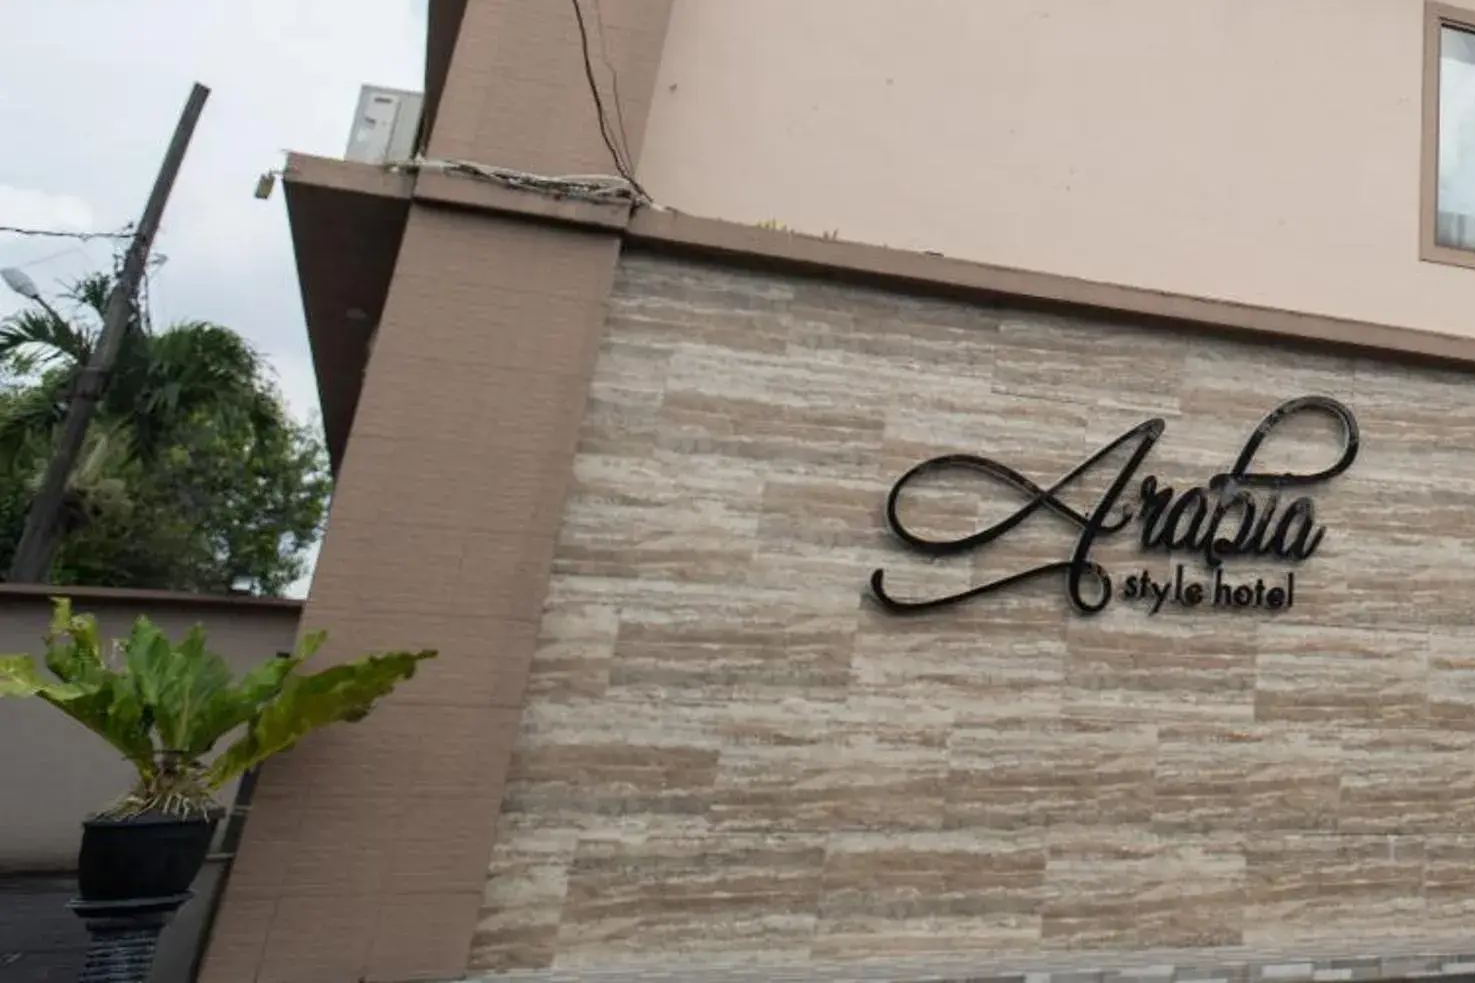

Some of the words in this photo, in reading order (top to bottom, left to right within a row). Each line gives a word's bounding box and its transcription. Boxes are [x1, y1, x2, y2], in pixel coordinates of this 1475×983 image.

[871, 395, 1359, 613] Arabia
[1123, 564, 1203, 614] style
[1214, 568, 1294, 609] hotel
